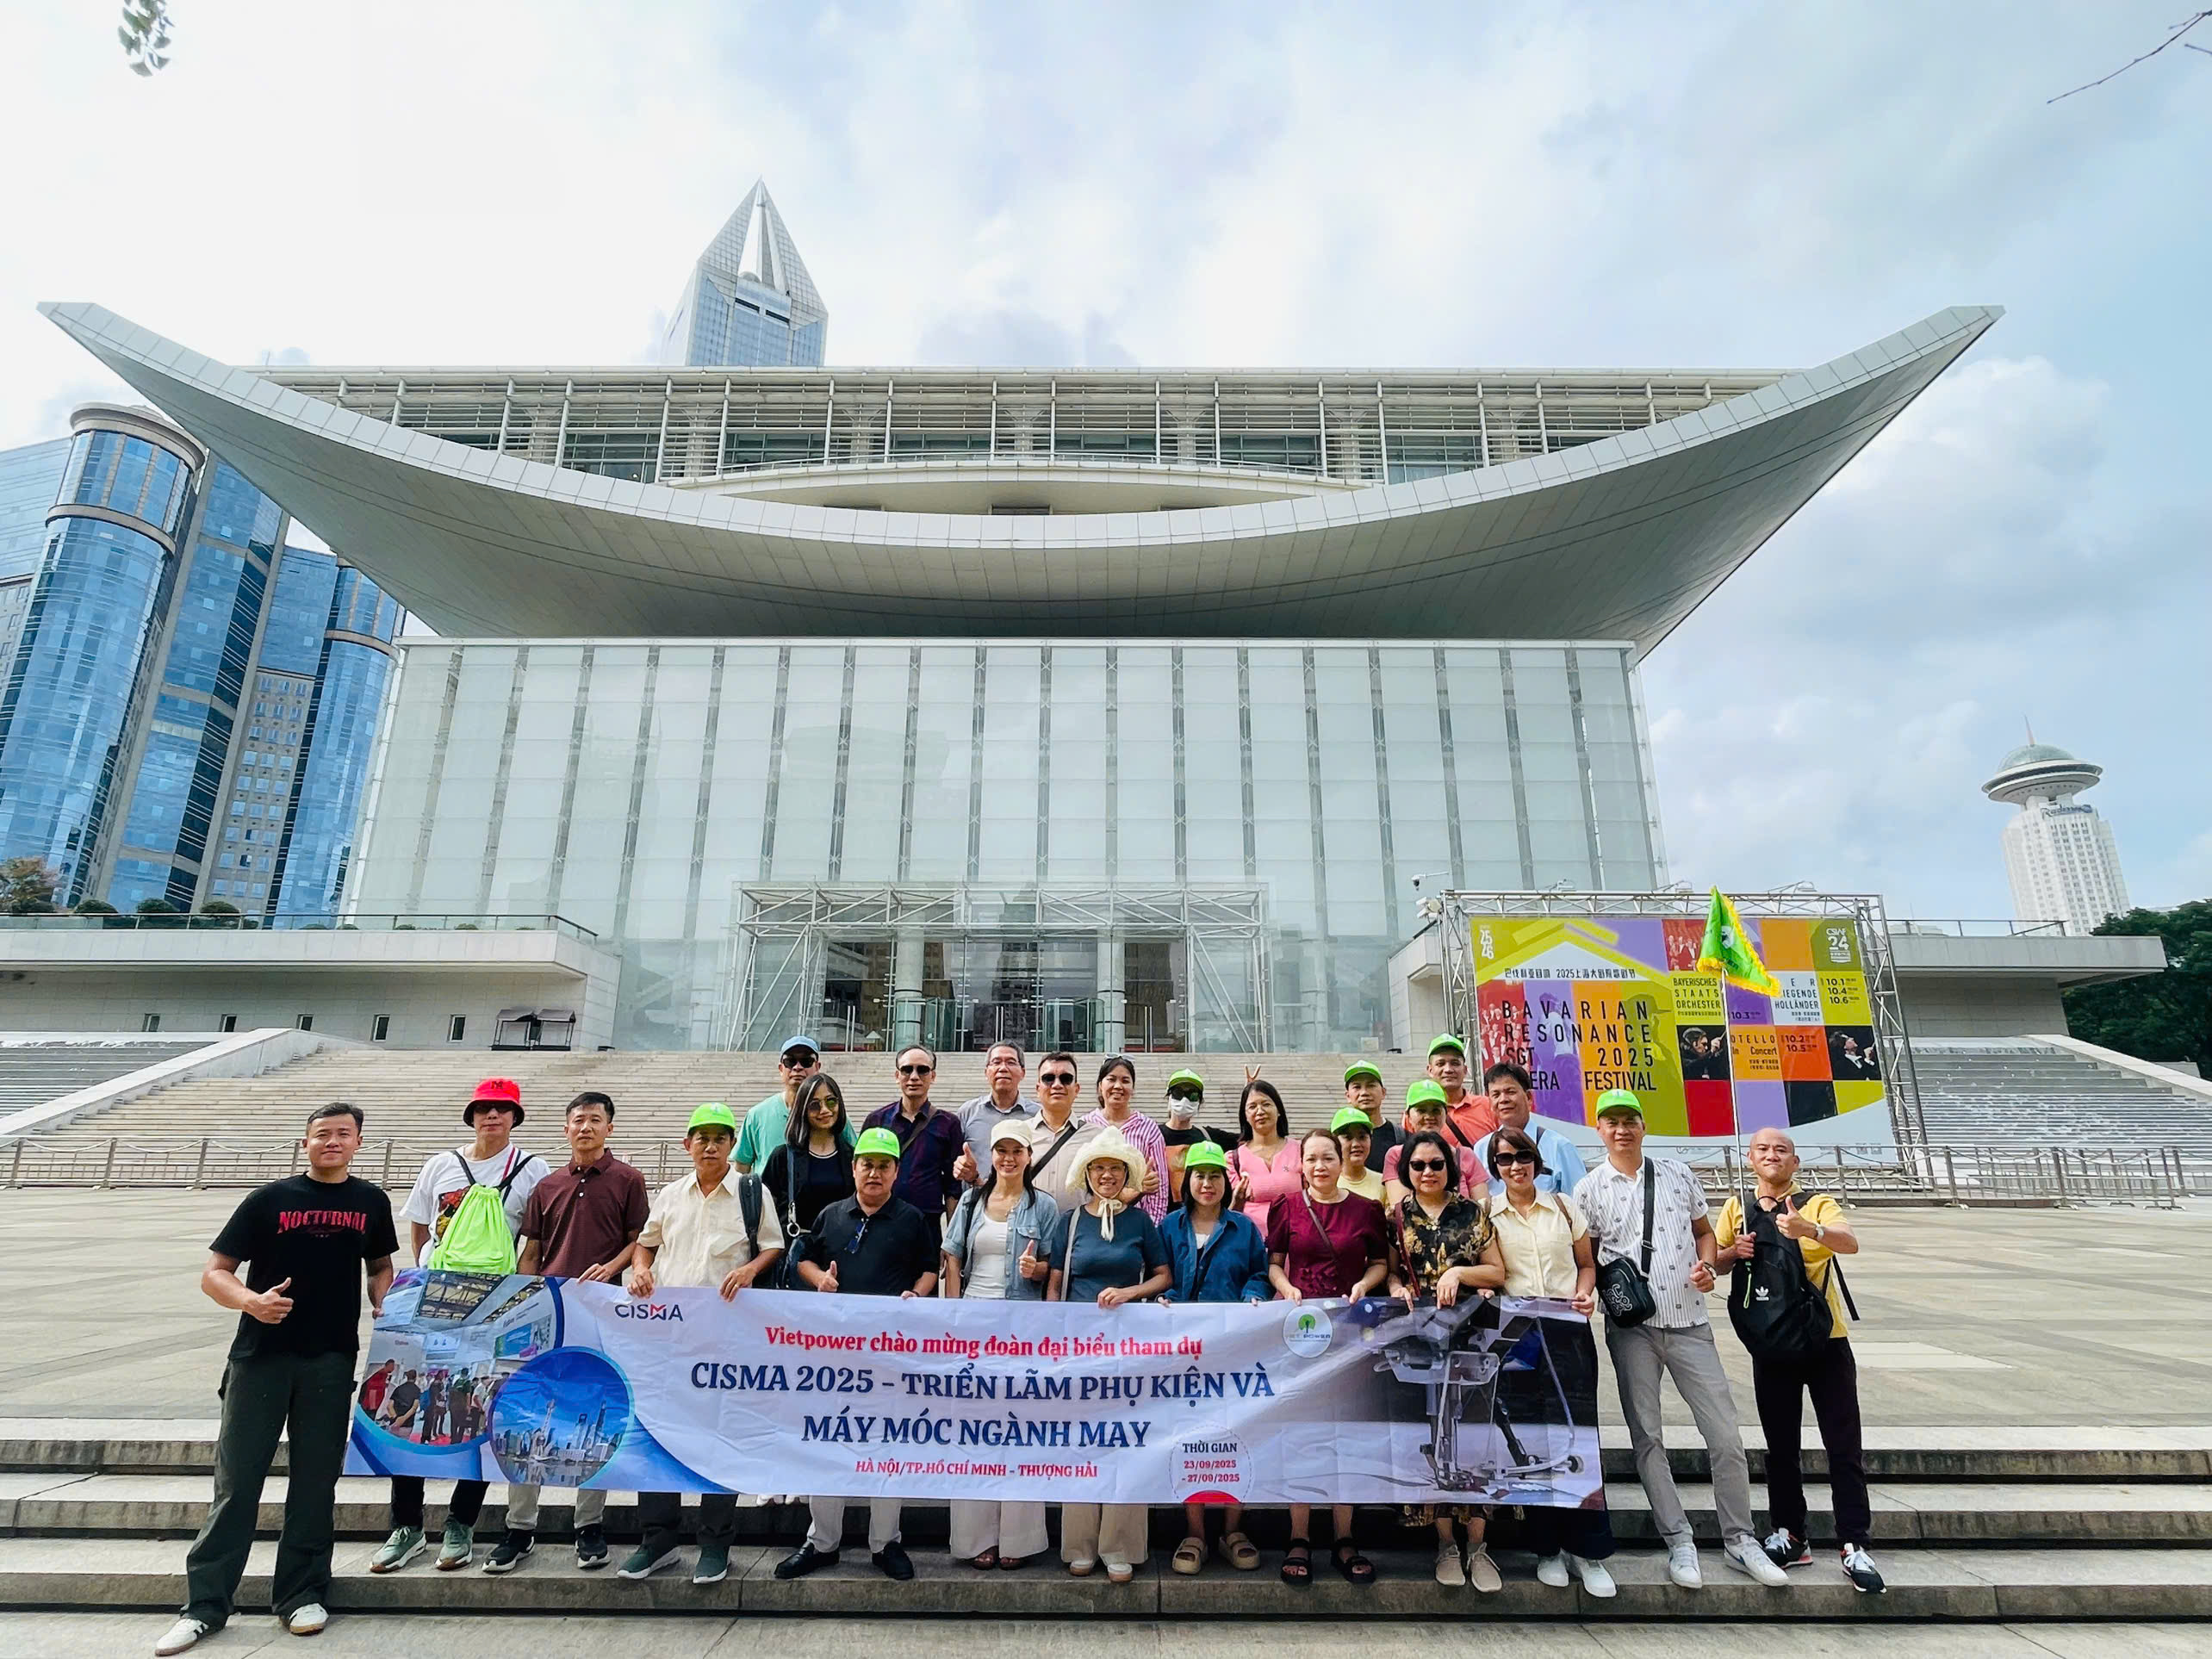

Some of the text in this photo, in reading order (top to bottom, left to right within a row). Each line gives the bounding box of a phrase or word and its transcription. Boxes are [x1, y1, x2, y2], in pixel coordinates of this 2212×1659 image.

[1828, 935, 1849, 950] 24
[1673, 978, 1718, 986] BAYERISCHES
[1826, 978, 1845, 986] 10.1
[1675, 989, 1719, 997] STAATS
[1782, 989, 1817, 998] IEGENDE
[1676, 1000, 1721, 1009] ORCHESTER
[1830, 996, 1849, 1004] 10.6
[1501, 1000, 1648, 1020] BAVARIAN
[1731, 1011, 1750, 1020] 10.3
[1504, 1023, 1652, 1043] RESONANCE
[1730, 1035, 1775, 1044] OTELLO
[1786, 1035, 1805, 1043] 10.2
[1750, 1046, 1777, 1055] Concert
[1786, 1044, 1806, 1053] 10.5
[1507, 1047, 1654, 1067] SGT 2025
[1530, 1071, 1656, 1090] ERA FESTIVAL
[614, 1303, 684, 1322] CISMA
[765, 1326, 867, 1351] Vietpower
[870, 1330, 917, 1353] chào
[922, 1332, 980, 1359] mừng
[984, 1333, 1033, 1356] đoàn
[1037, 1336, 1068, 1362] đại
[1072, 1333, 1115, 1357] biểu
[1119, 1337, 1173, 1356] tham
[691, 1362, 790, 1391] CISMA
[795, 1365, 873, 1394] 2025
[901, 1363, 998, 1400] TRIỂN
[1004, 1369, 1072, 1401] LÃM
[1078, 1376, 1144, 1407] PHỤ
[1150, 1365, 1226, 1407] KIỆN
[1229, 1362, 1276, 1398] VÀ
[801, 1405, 1152, 1448] MÁY MÓC NGÀNH MAY
[1182, 1439, 1238, 1454] THỜI GIAN
[855, 1457, 874, 1474] HÀ
[947, 1459, 969, 1476] CHÍ
[971, 1463, 1007, 1476] MINH
[1018, 1463, 1072, 1481] THƯỢNG
[1075, 1461, 1098, 1477] HẢI
[1184, 1459, 1237, 1470] 23/09/2025
[1187, 1473, 1240, 1484] 27/09/2025
